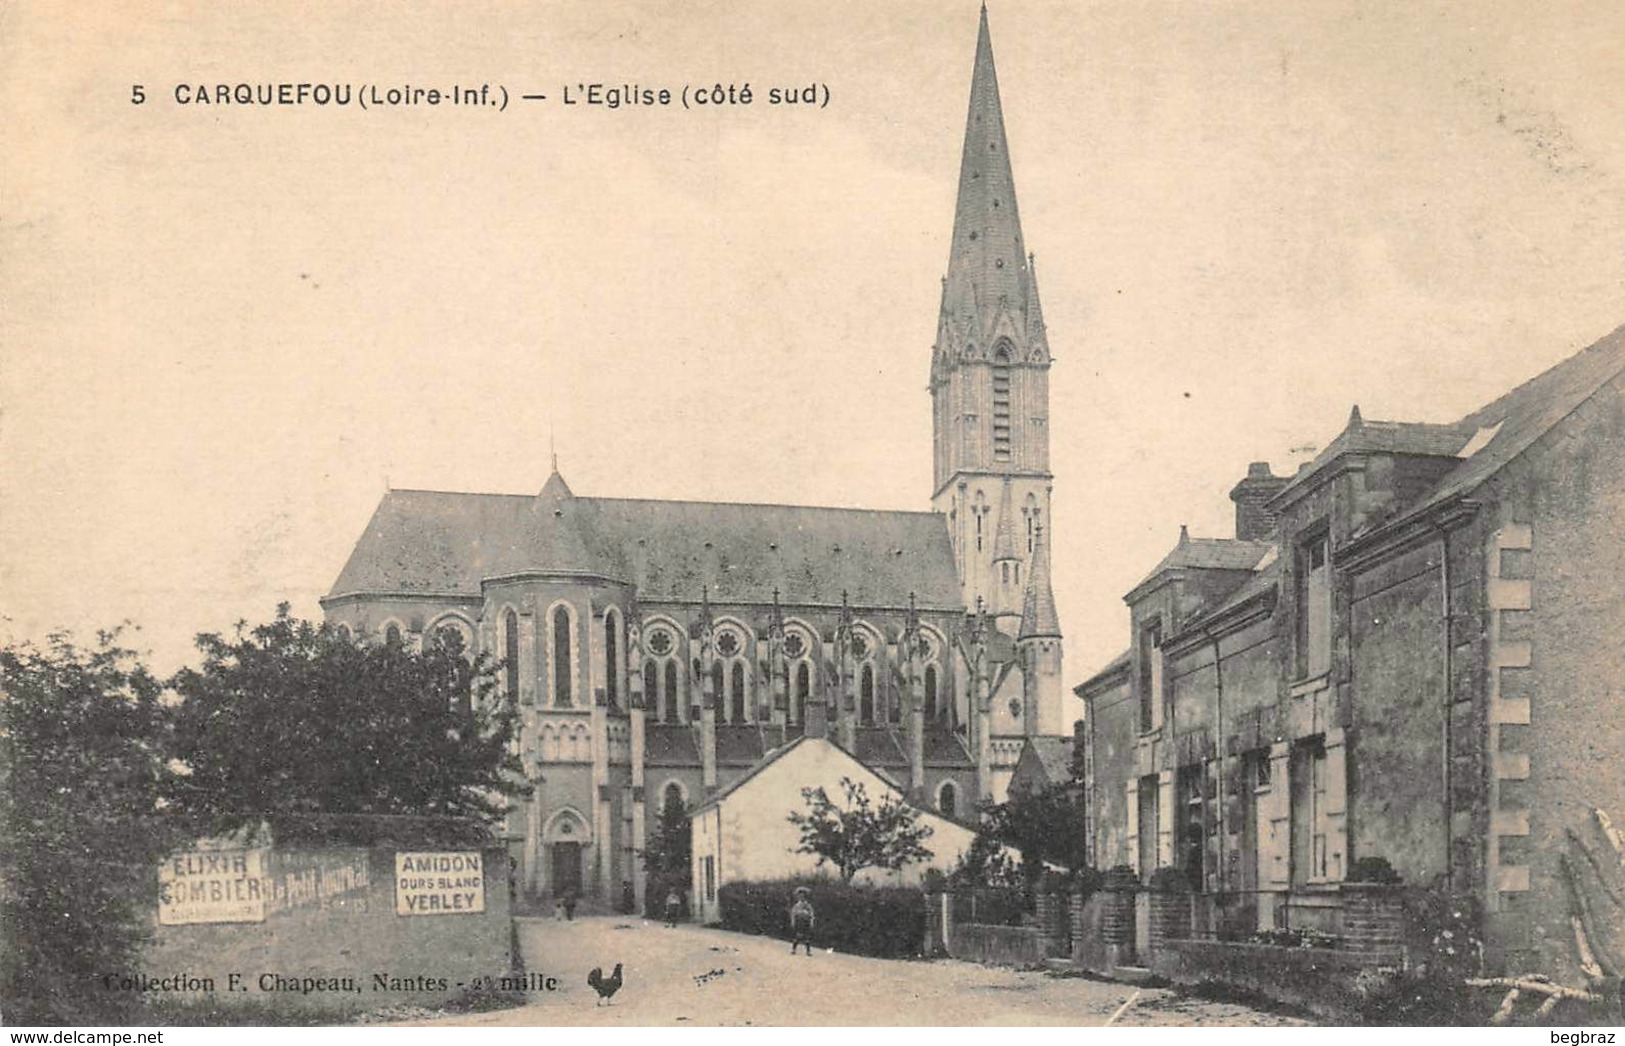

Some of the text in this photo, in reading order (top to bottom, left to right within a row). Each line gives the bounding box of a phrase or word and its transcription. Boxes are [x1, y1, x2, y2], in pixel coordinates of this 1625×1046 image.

[173, 856, 248, 876] ELIXIR
[402, 857, 479, 872] AMIDON
[400, 877, 481, 889] OURS BLANC
[405, 893, 475, 911] VERLEY
